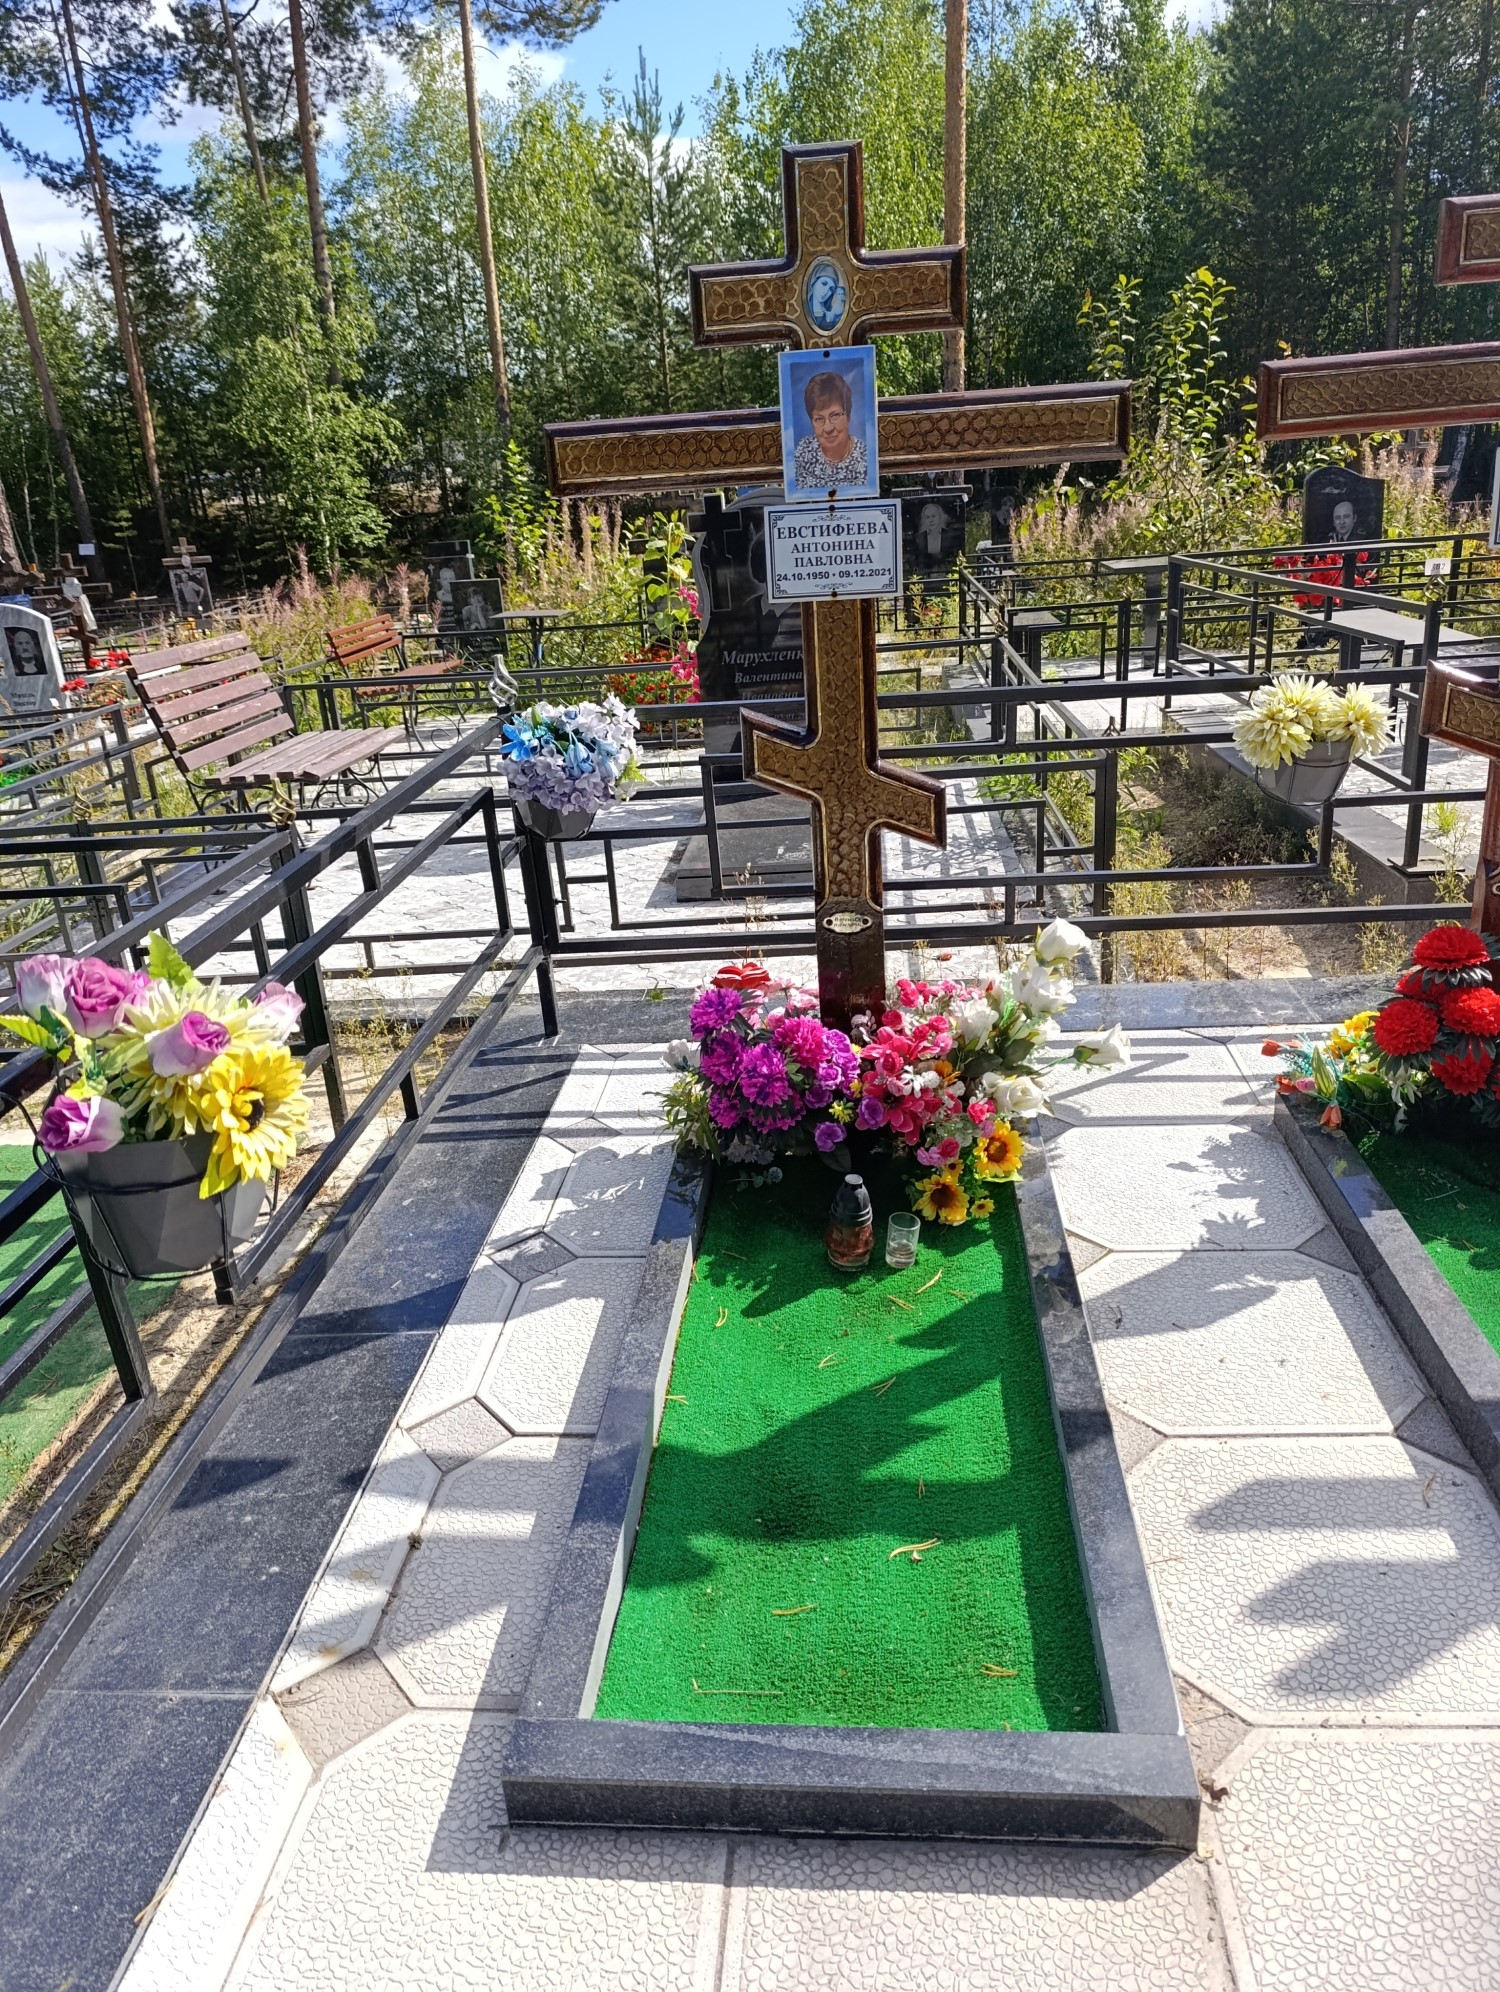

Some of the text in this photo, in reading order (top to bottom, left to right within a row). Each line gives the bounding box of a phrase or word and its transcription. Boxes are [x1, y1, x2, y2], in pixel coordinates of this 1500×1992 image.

[776, 521, 889, 540] ЕВСТИФЕЕВА
[791, 539, 875, 554] АНТОНИНА
[794, 553, 874, 568] ПАВЛОВНА
[776, 568, 892, 582] 24.10.1950 09.12.2021
[721, 650, 804, 667] Марухленк
[734, 672, 803, 684] Валентина
